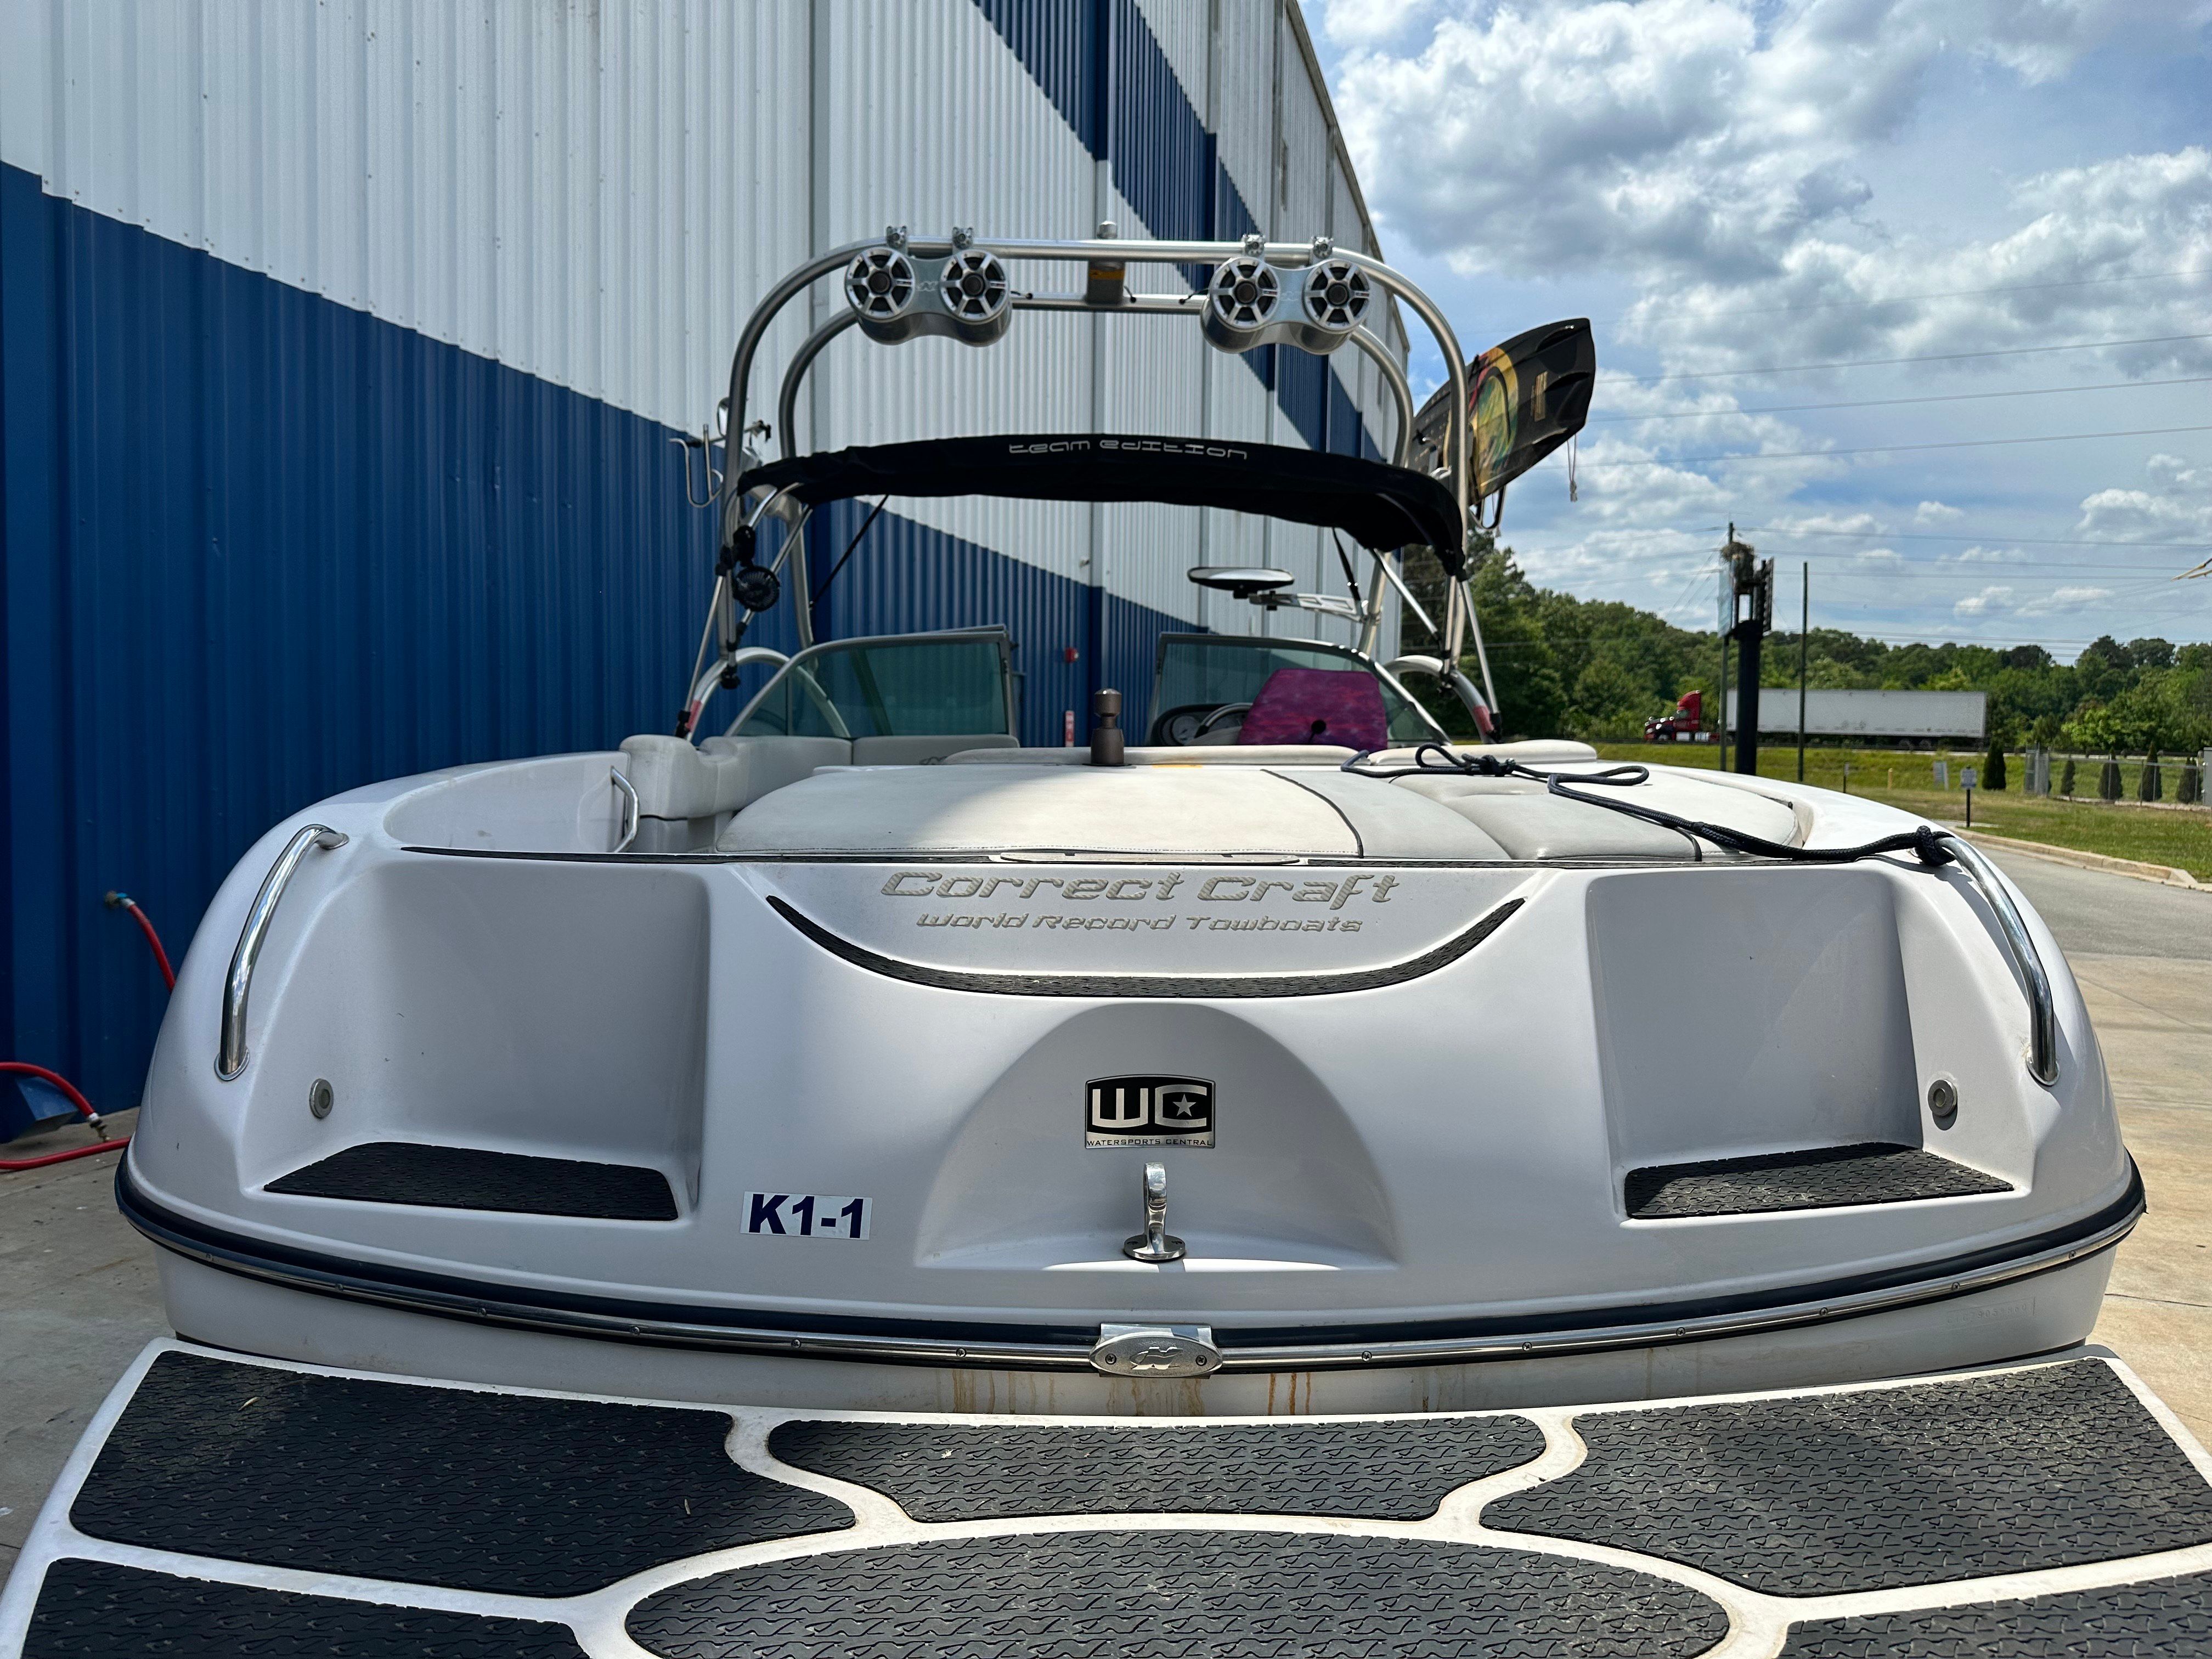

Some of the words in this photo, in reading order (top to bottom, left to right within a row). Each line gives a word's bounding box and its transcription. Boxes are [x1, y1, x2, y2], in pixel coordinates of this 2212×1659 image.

[881, 871, 1183, 901] Correct
[1197, 874, 1399, 910] Craft
[916, 912, 1029, 929] World
[1032, 914, 1176, 932] Record
[1186, 915, 1363, 932] Towboats
[1092, 1084, 1207, 1128] WC
[749, 1194, 864, 1238] K1-1
